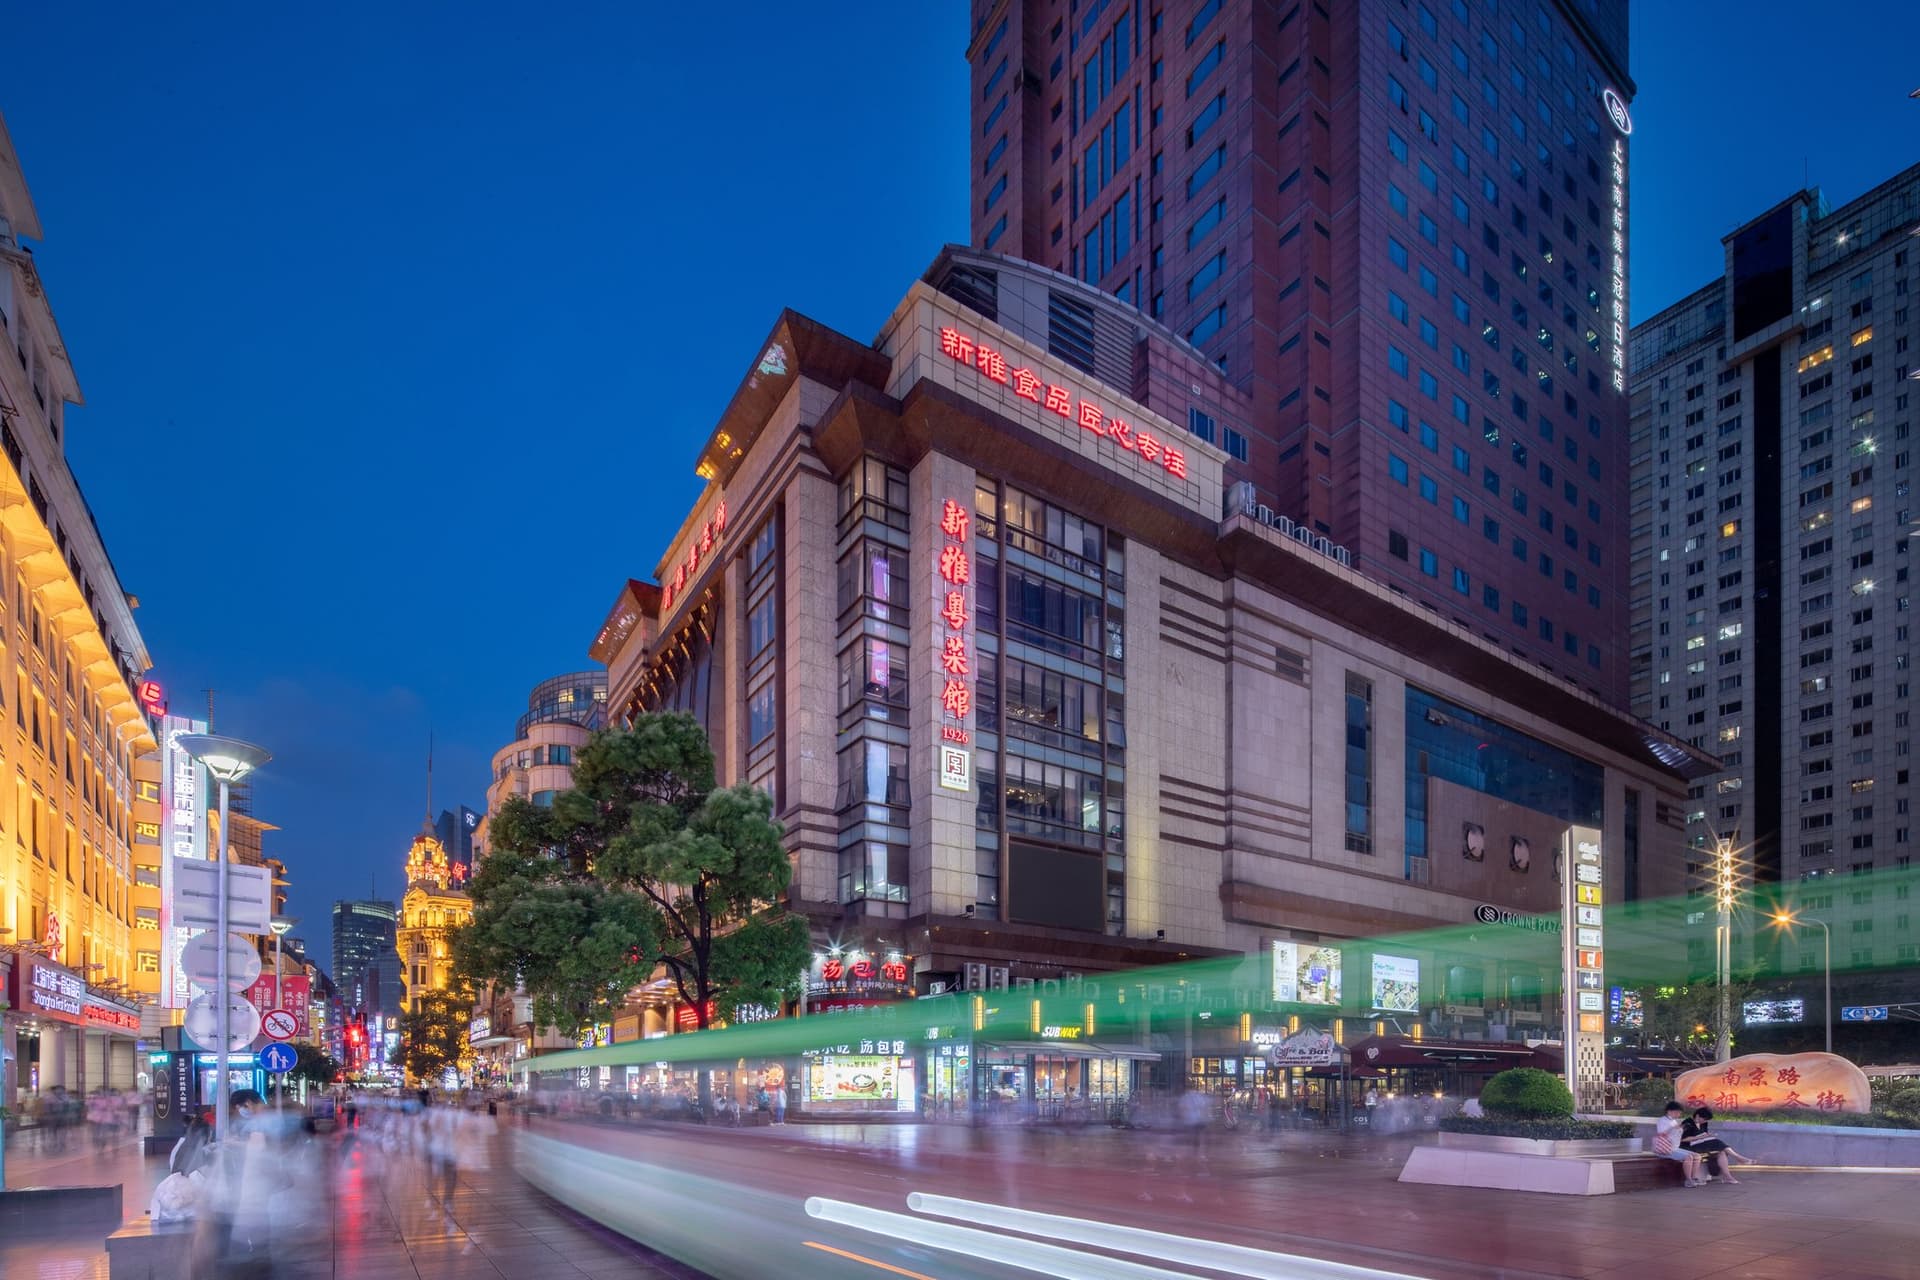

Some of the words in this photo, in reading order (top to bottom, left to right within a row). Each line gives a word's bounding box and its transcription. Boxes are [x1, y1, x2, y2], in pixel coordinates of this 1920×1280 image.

[940, 326, 1188, 479] 新雅食品匠心专注
[942, 727, 969, 744] 1926
[1501, 911, 1536, 930] CROWNE
[822, 959, 908, 982] 汤包馆
[1042, 1026, 1082, 1038] SUBWAY
[1253, 1032, 1280, 1044] COSTA
[860, 1040, 905, 1055] 汤包馆
[1721, 1066, 1801, 1087] 南京路
